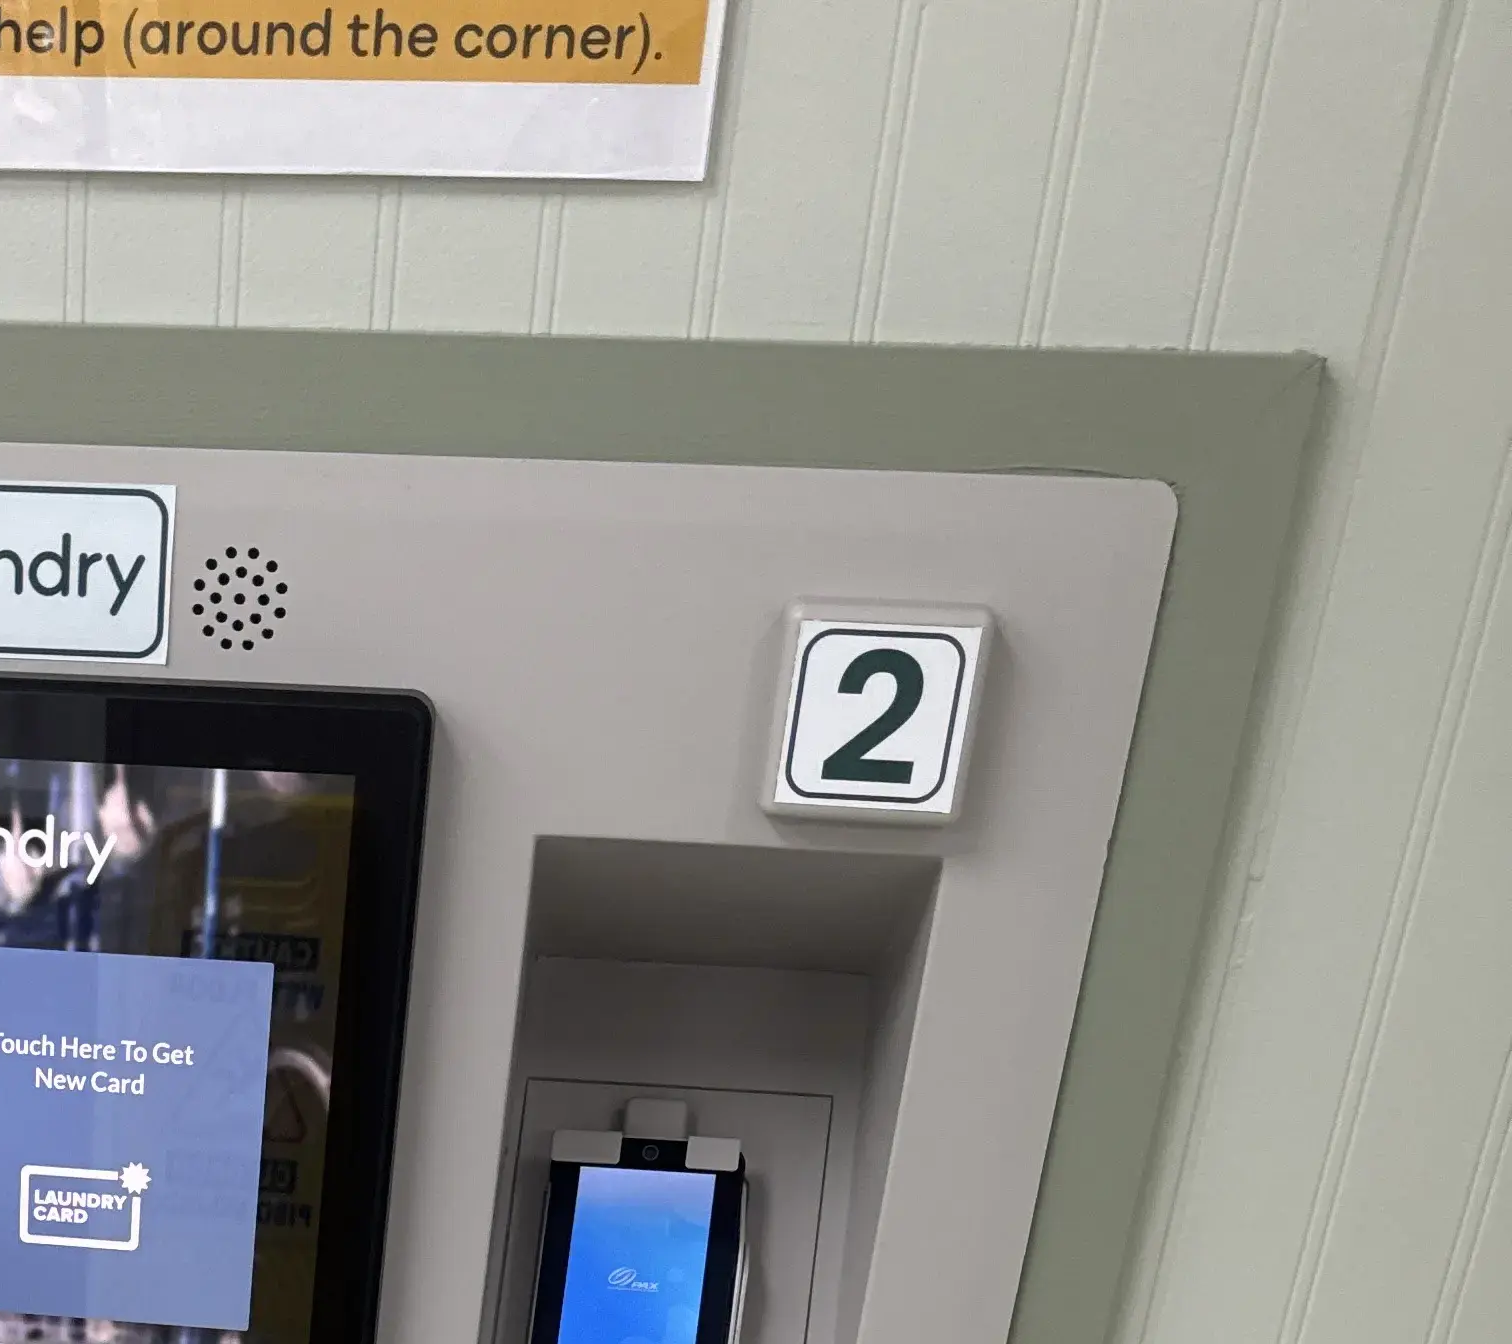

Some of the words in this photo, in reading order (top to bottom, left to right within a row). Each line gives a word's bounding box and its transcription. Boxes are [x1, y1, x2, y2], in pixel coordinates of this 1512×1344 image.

[121, 8, 331, 69] (around
[351, 12, 438, 60] the
[453, 15, 663, 76] corner).
[821, 648, 924, 784] 2
[60, 1036, 116, 1061] Here
[120, 1040, 148, 1063] To
[152, 1042, 195, 1066] Get
[34, 1067, 88, 1091] New
[90, 1071, 145, 1095] Card
[33, 1188, 128, 1211] LAUNDRY
[33, 1205, 88, 1224] CARD
